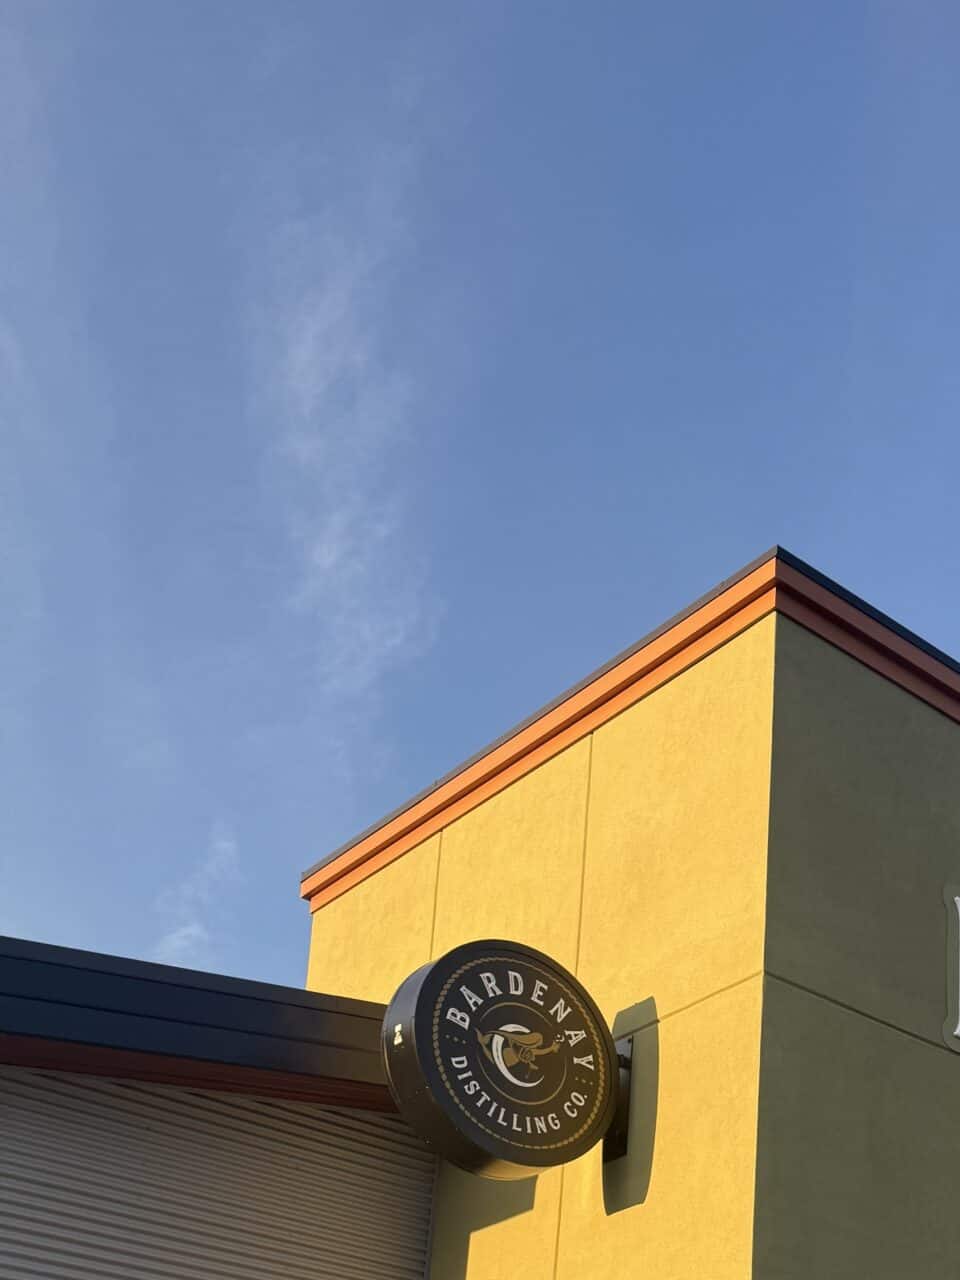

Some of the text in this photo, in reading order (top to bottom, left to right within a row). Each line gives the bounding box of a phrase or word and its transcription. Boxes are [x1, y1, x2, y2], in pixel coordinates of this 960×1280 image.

[446, 970, 595, 1072] BARDENAY
[451, 1055, 588, 1134] DISTILLING CO.
